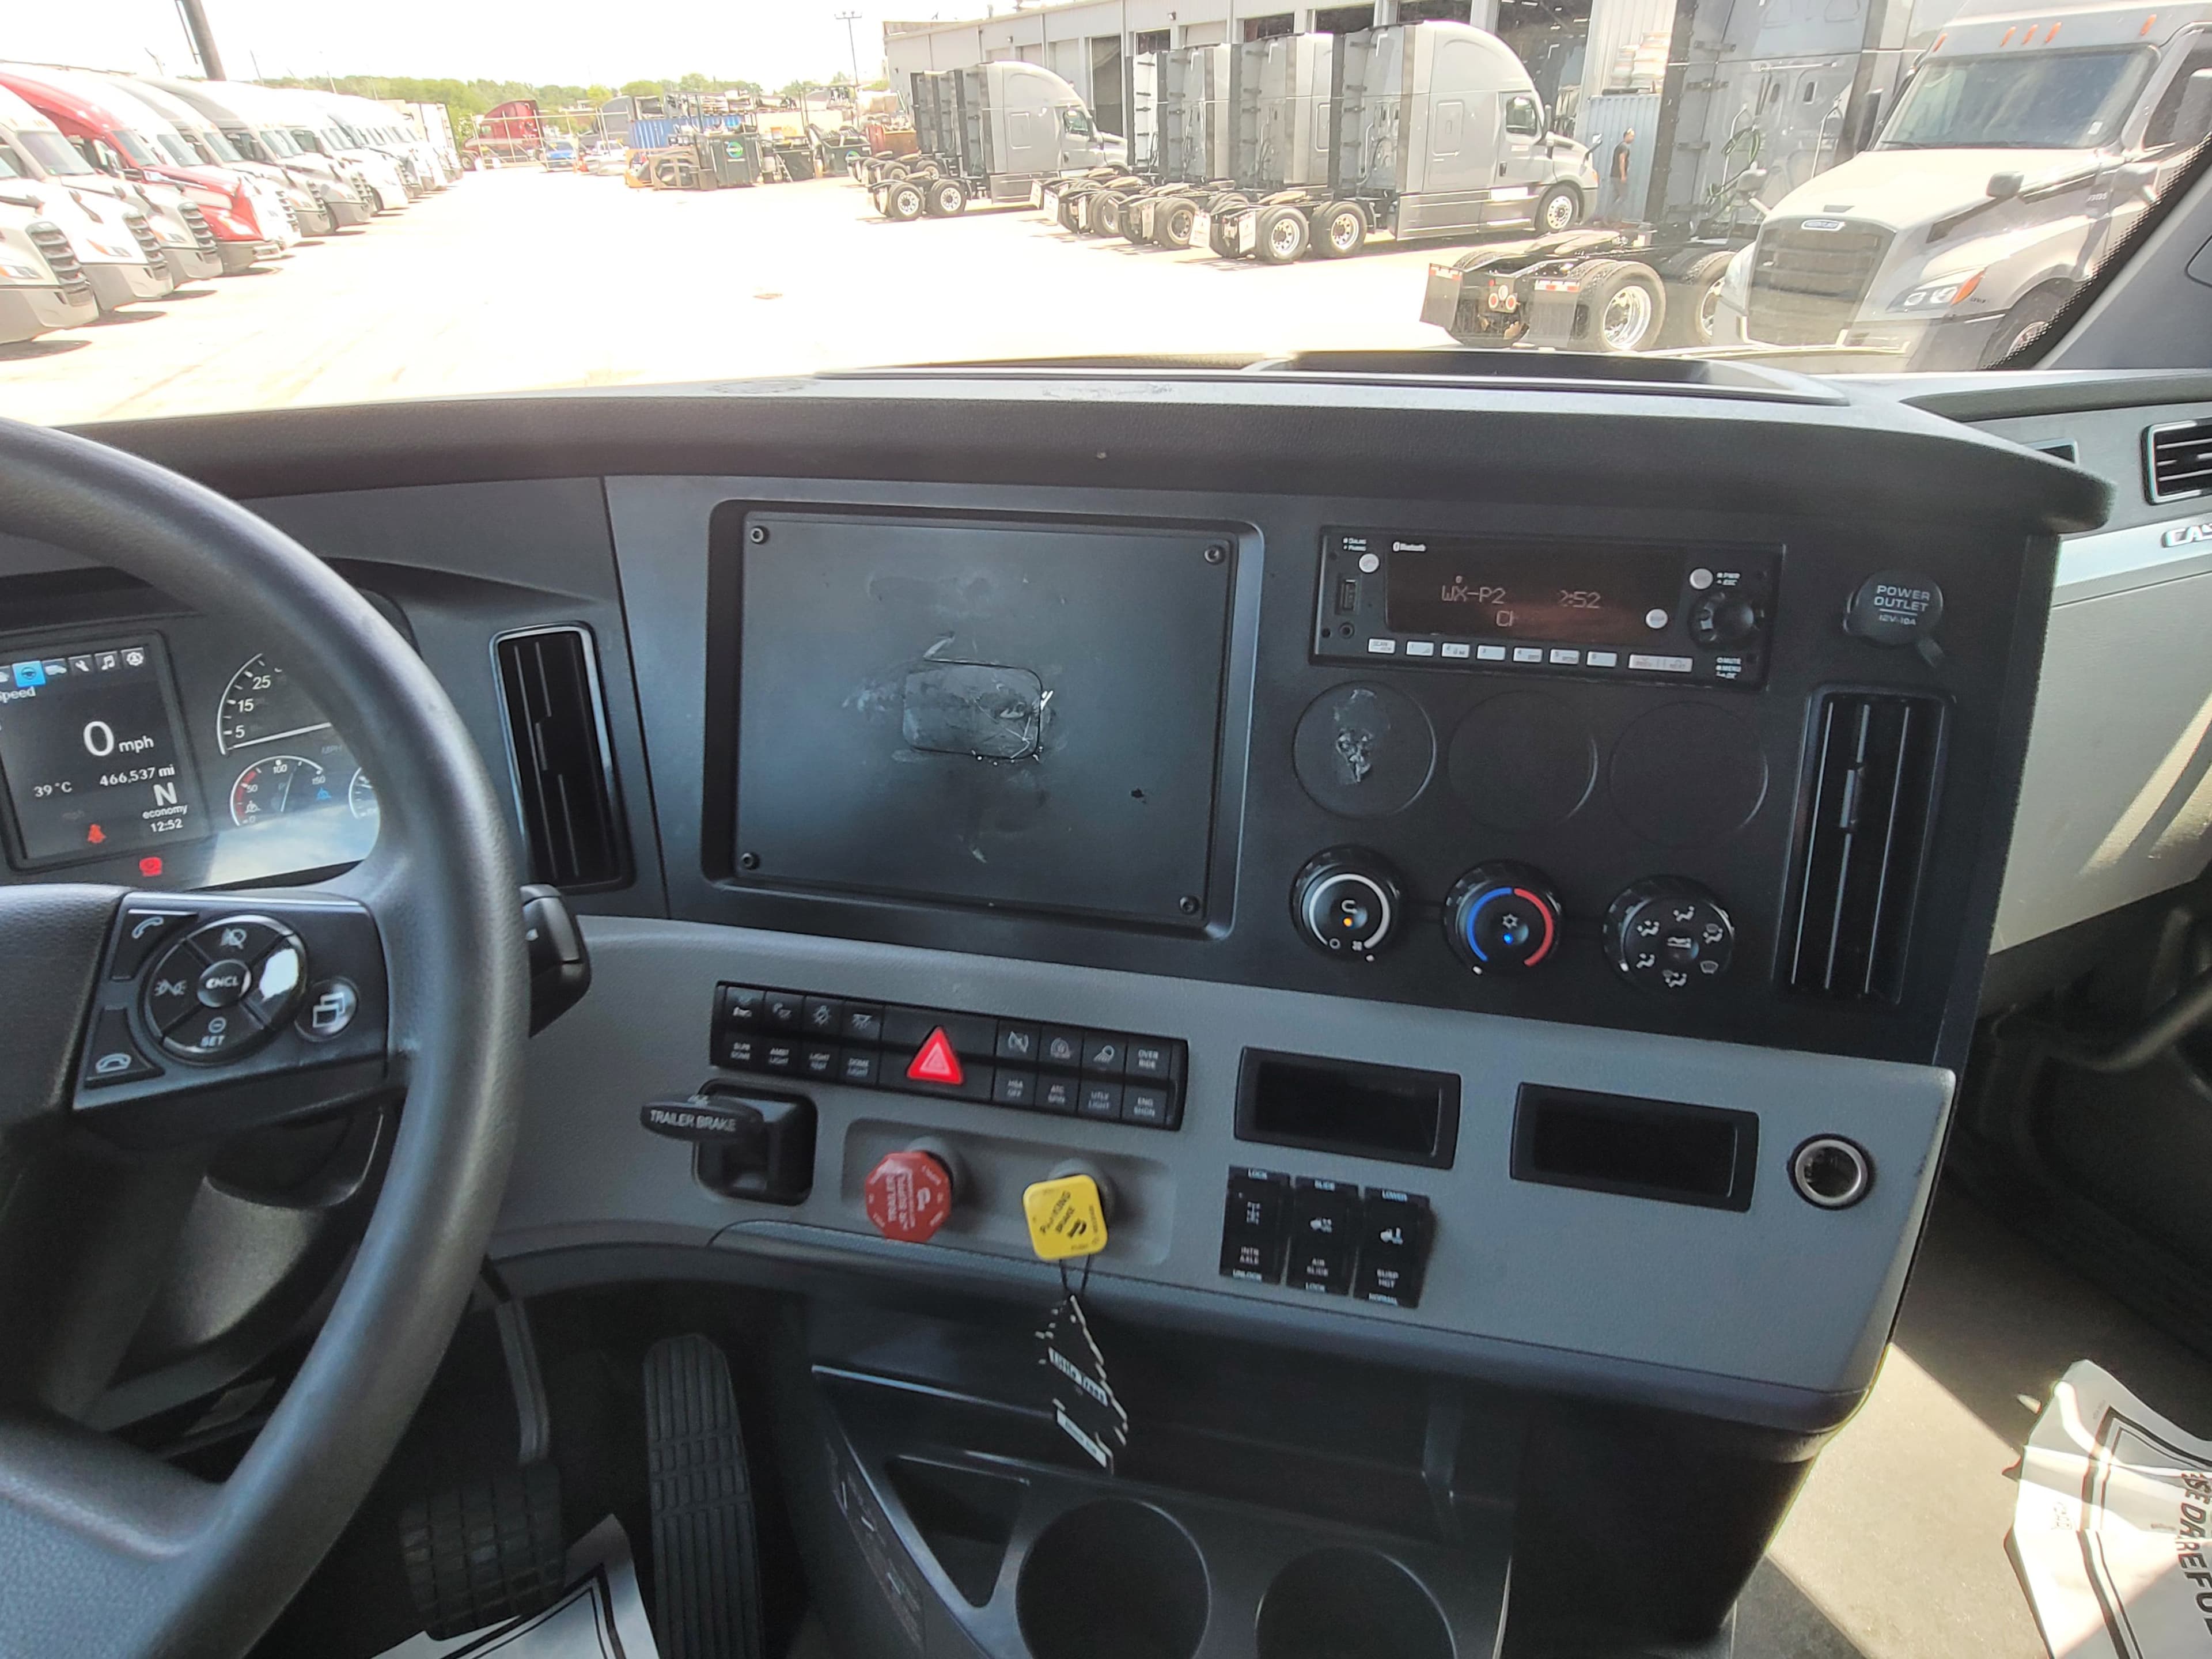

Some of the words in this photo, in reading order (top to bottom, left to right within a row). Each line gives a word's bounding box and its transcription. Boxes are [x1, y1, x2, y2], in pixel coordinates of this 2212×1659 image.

[1441, 585, 1507, 605] WX-P2
[1877, 585, 1930, 601] POWER
[1874, 596, 1929, 612] OUTLET
[252, 674, 271, 690] 25
[237, 698, 255, 713] 15
[83, 720, 115, 757] 0
[118, 735, 154, 753] mph
[234, 724, 245, 738] 5
[99, 767, 156, 788] 466,537
[158, 764, 176, 777] mi
[272, 764, 288, 774] 100
[312, 775, 326, 785] 150
[33, 785, 52, 798] 39
[153, 782, 179, 806] N
[246, 784, 259, 793] 50
[142, 804, 188, 820] economy
[150, 818, 184, 833] 12:52
[206, 977, 240, 990] CNCL
[1138, 1049, 1159, 1060] OVER
[650, 1109, 695, 1127] TRAILER
[696, 1114, 737, 1132] BRAKE
